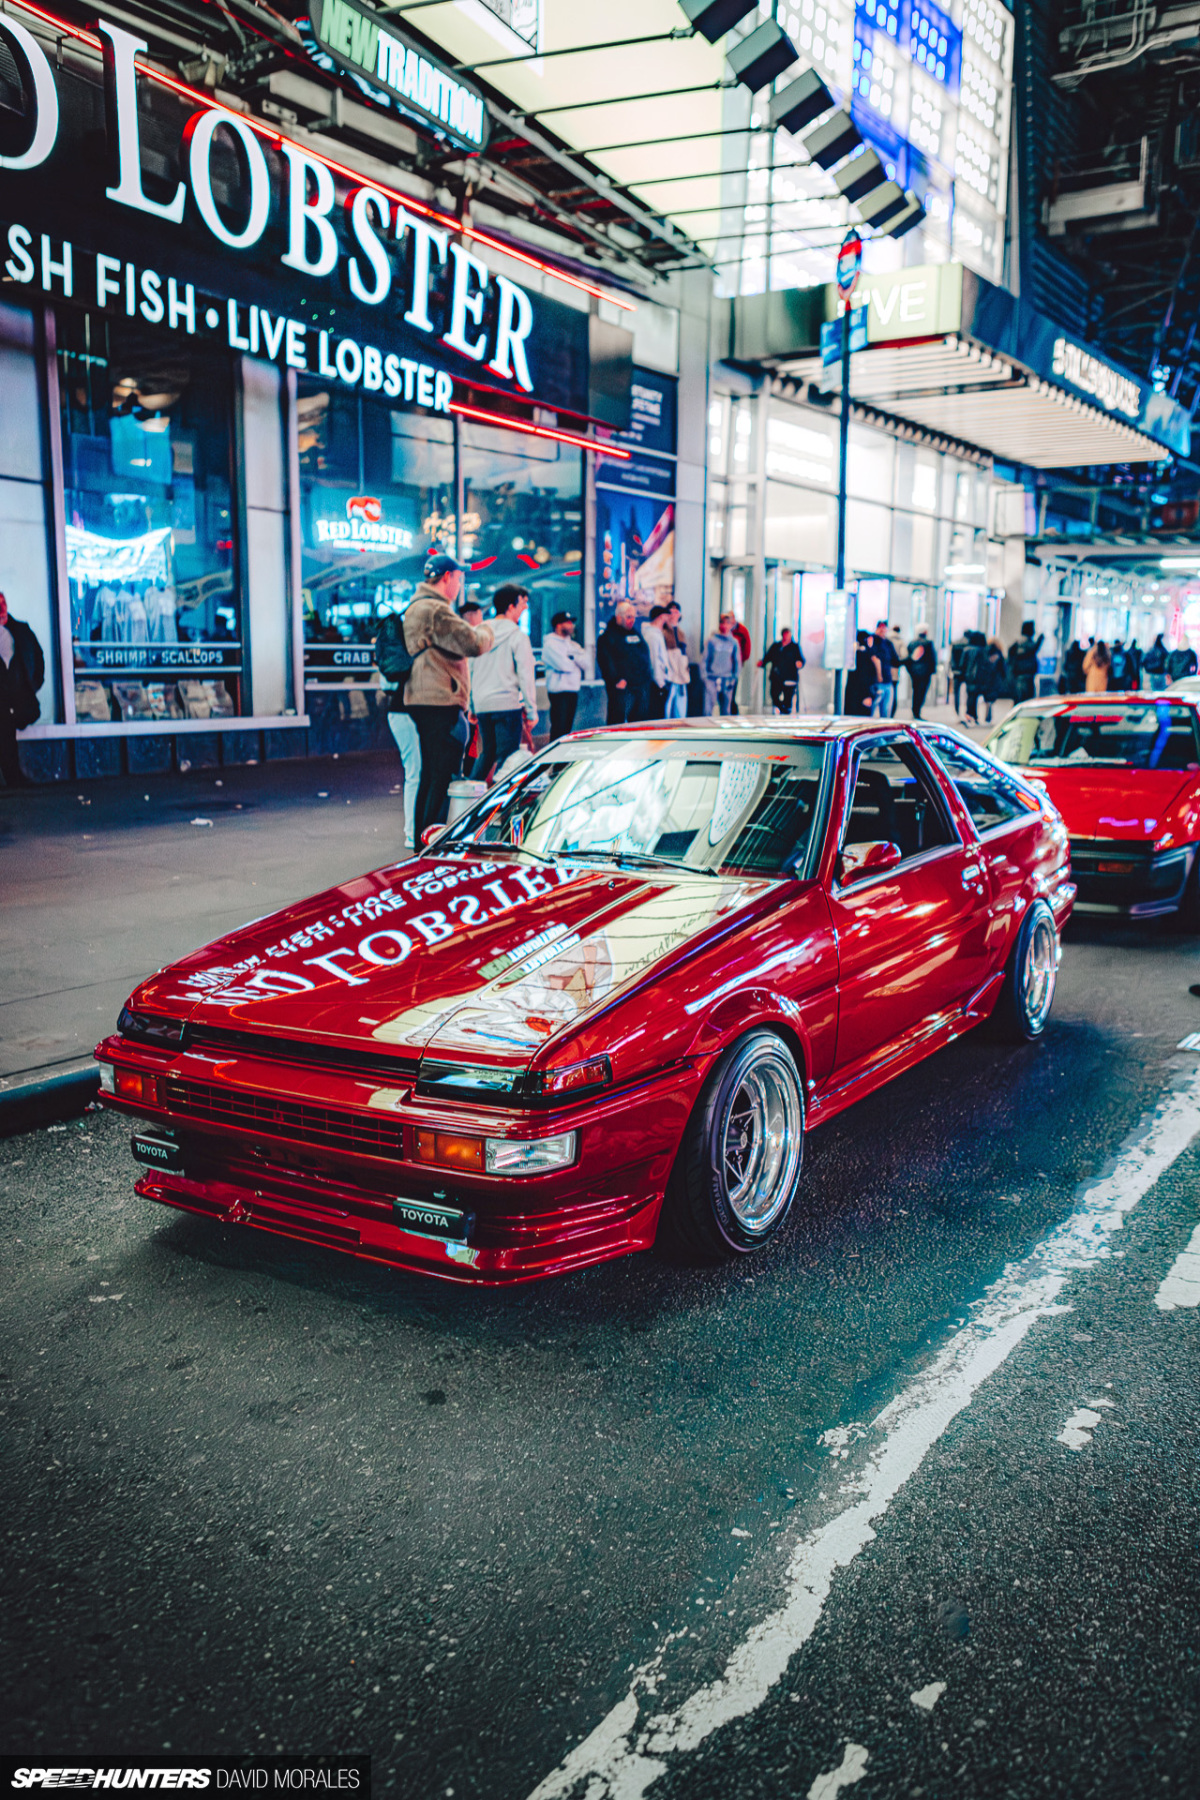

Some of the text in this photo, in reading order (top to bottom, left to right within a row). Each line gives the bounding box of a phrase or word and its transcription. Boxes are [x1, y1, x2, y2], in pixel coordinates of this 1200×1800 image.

[320, 0, 484, 145] NEW TRADITION
[98, 18, 534, 393] LOBSTER
[96, 253, 196, 335] FISH
[227, 297, 307, 369] LIVE
[319, 329, 453, 413] LOBSTER
[316, 519, 351, 542] RED
[350, 518, 413, 550] LOBSTER
[96, 650, 224, 665] SHRIMP SCALLOPS
[333, 651, 371, 664] CRAB
[136, 1142, 168, 1160] TOYOTA
[400, 1208, 449, 1228] TOYOTA
